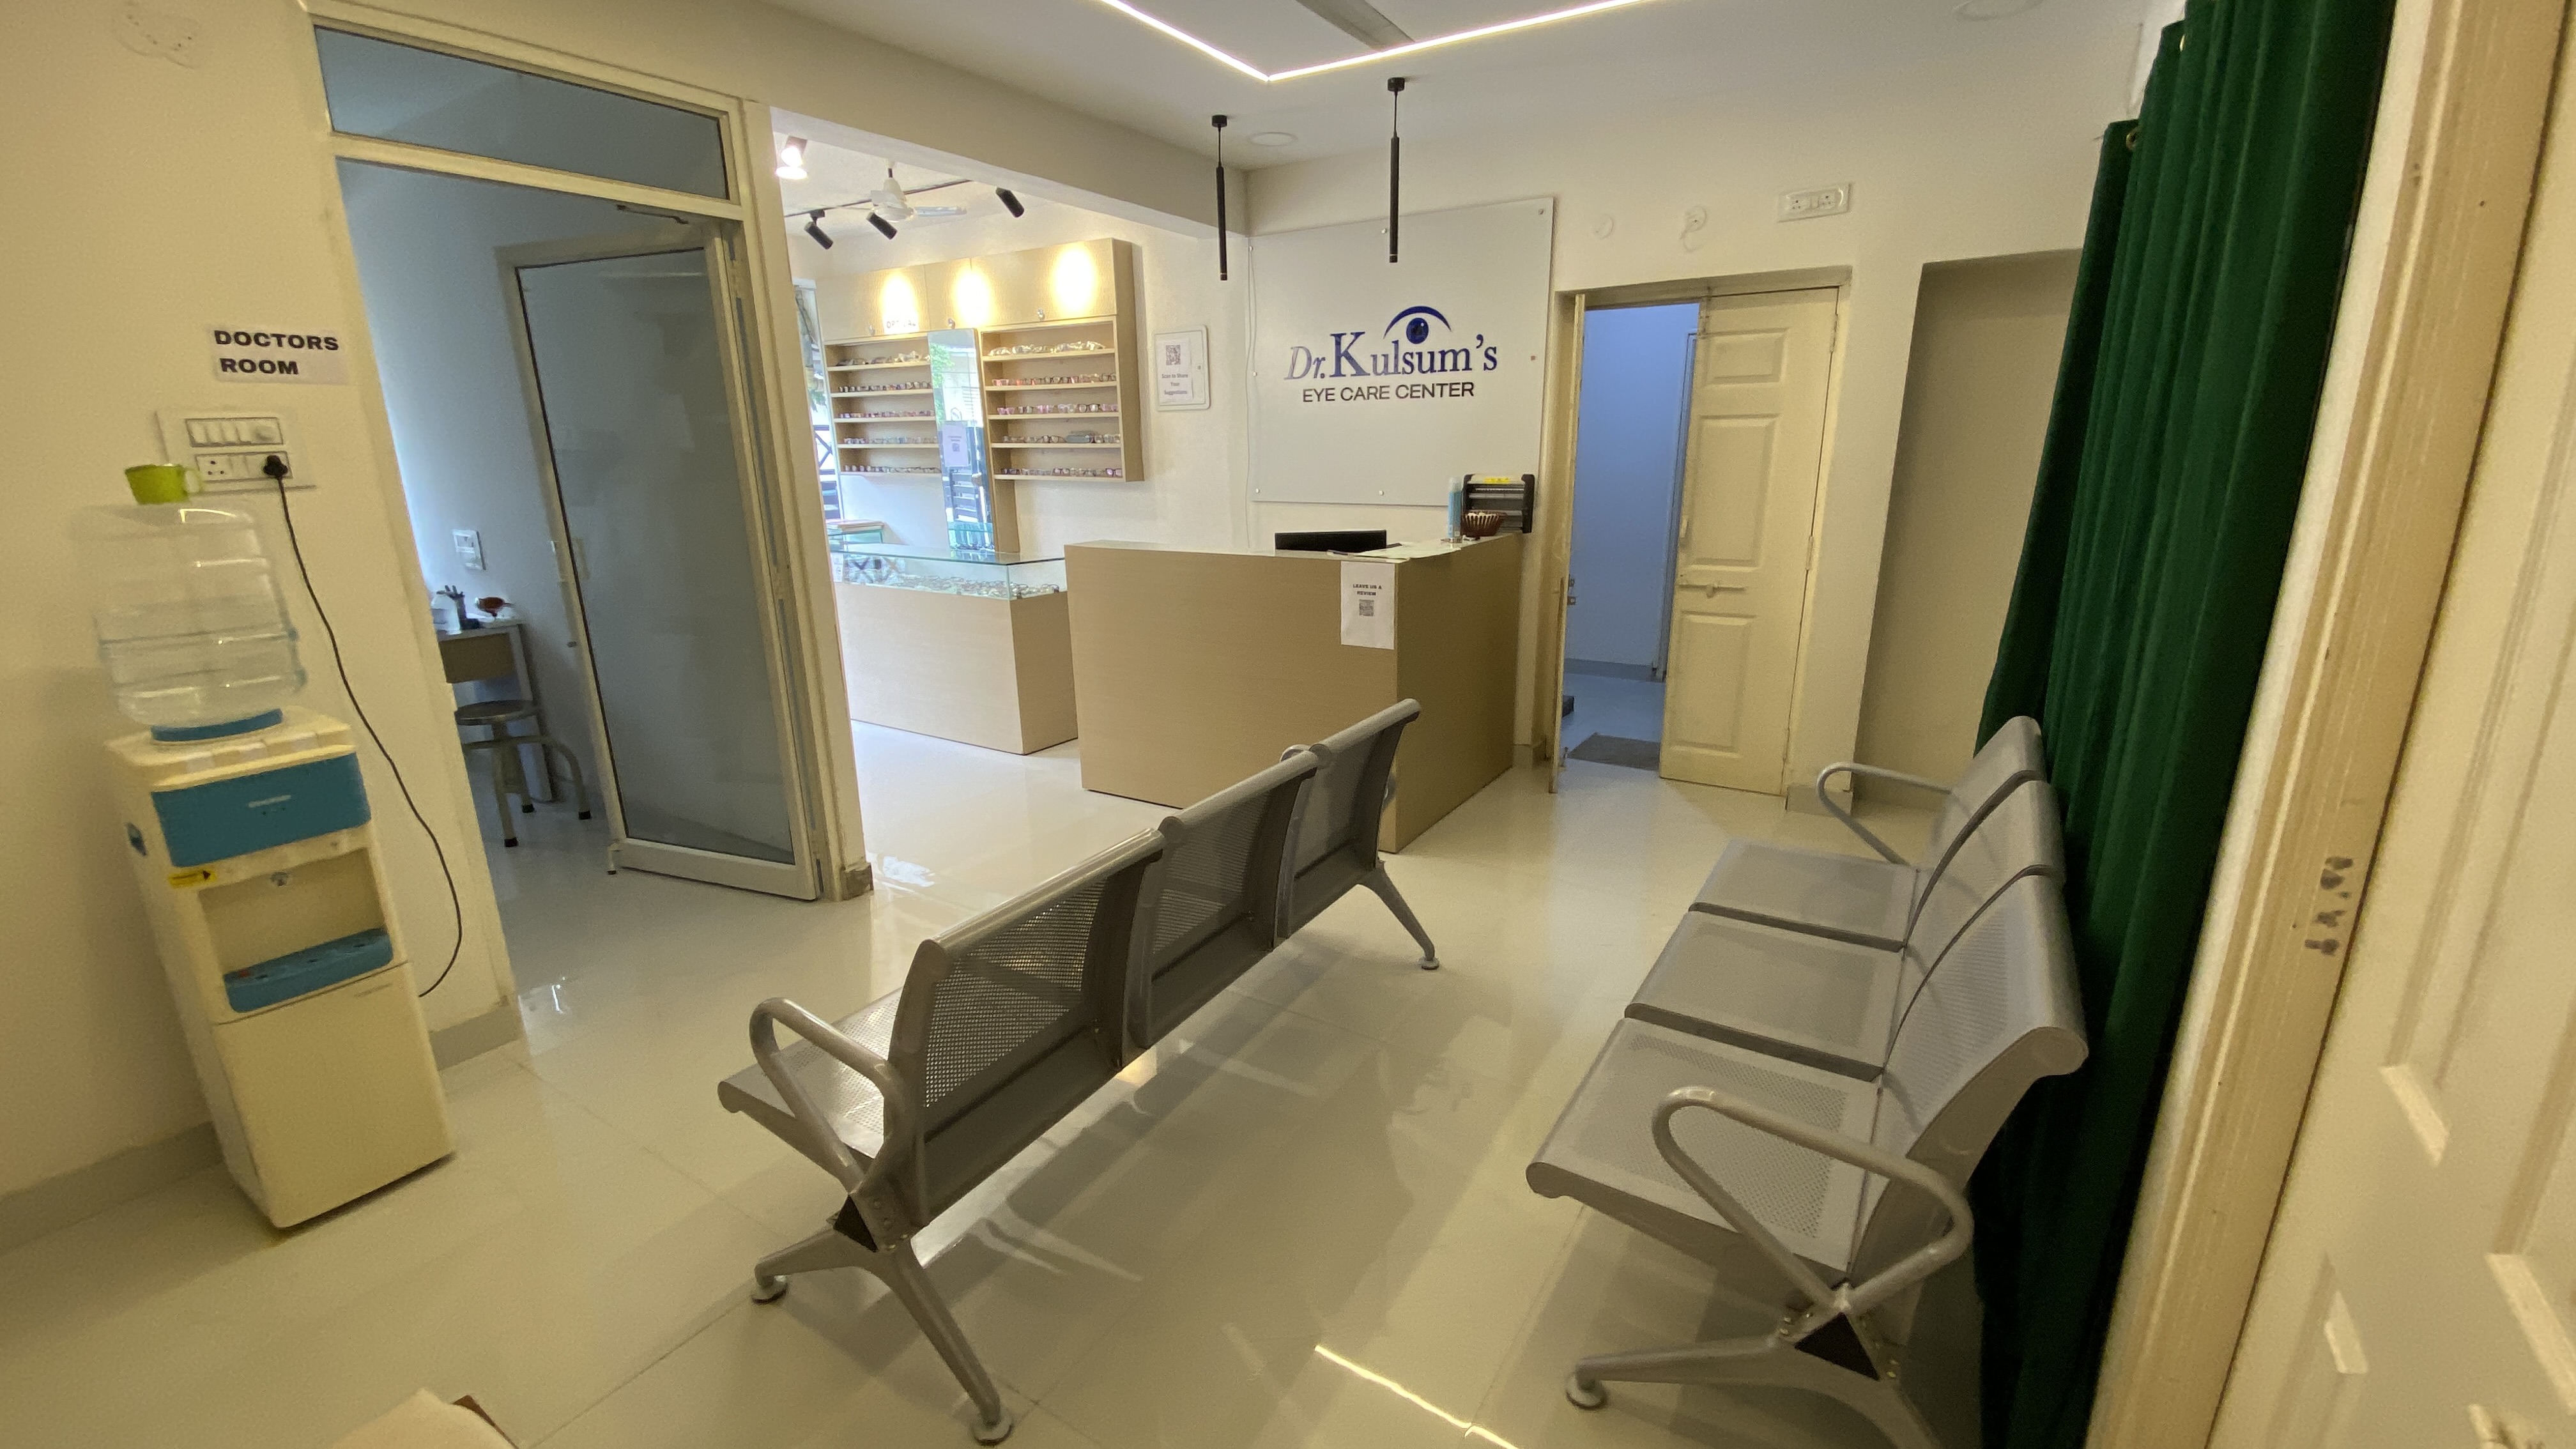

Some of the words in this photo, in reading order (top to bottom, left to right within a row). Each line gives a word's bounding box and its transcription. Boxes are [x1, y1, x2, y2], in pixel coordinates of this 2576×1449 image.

[214, 330, 339, 351] DOCTORS
[219, 358, 299, 375] ROOM
[1303, 387, 1336, 402] EYE
[1340, 385, 1390, 401] CARE
[1395, 381, 1475, 399] CENTER
